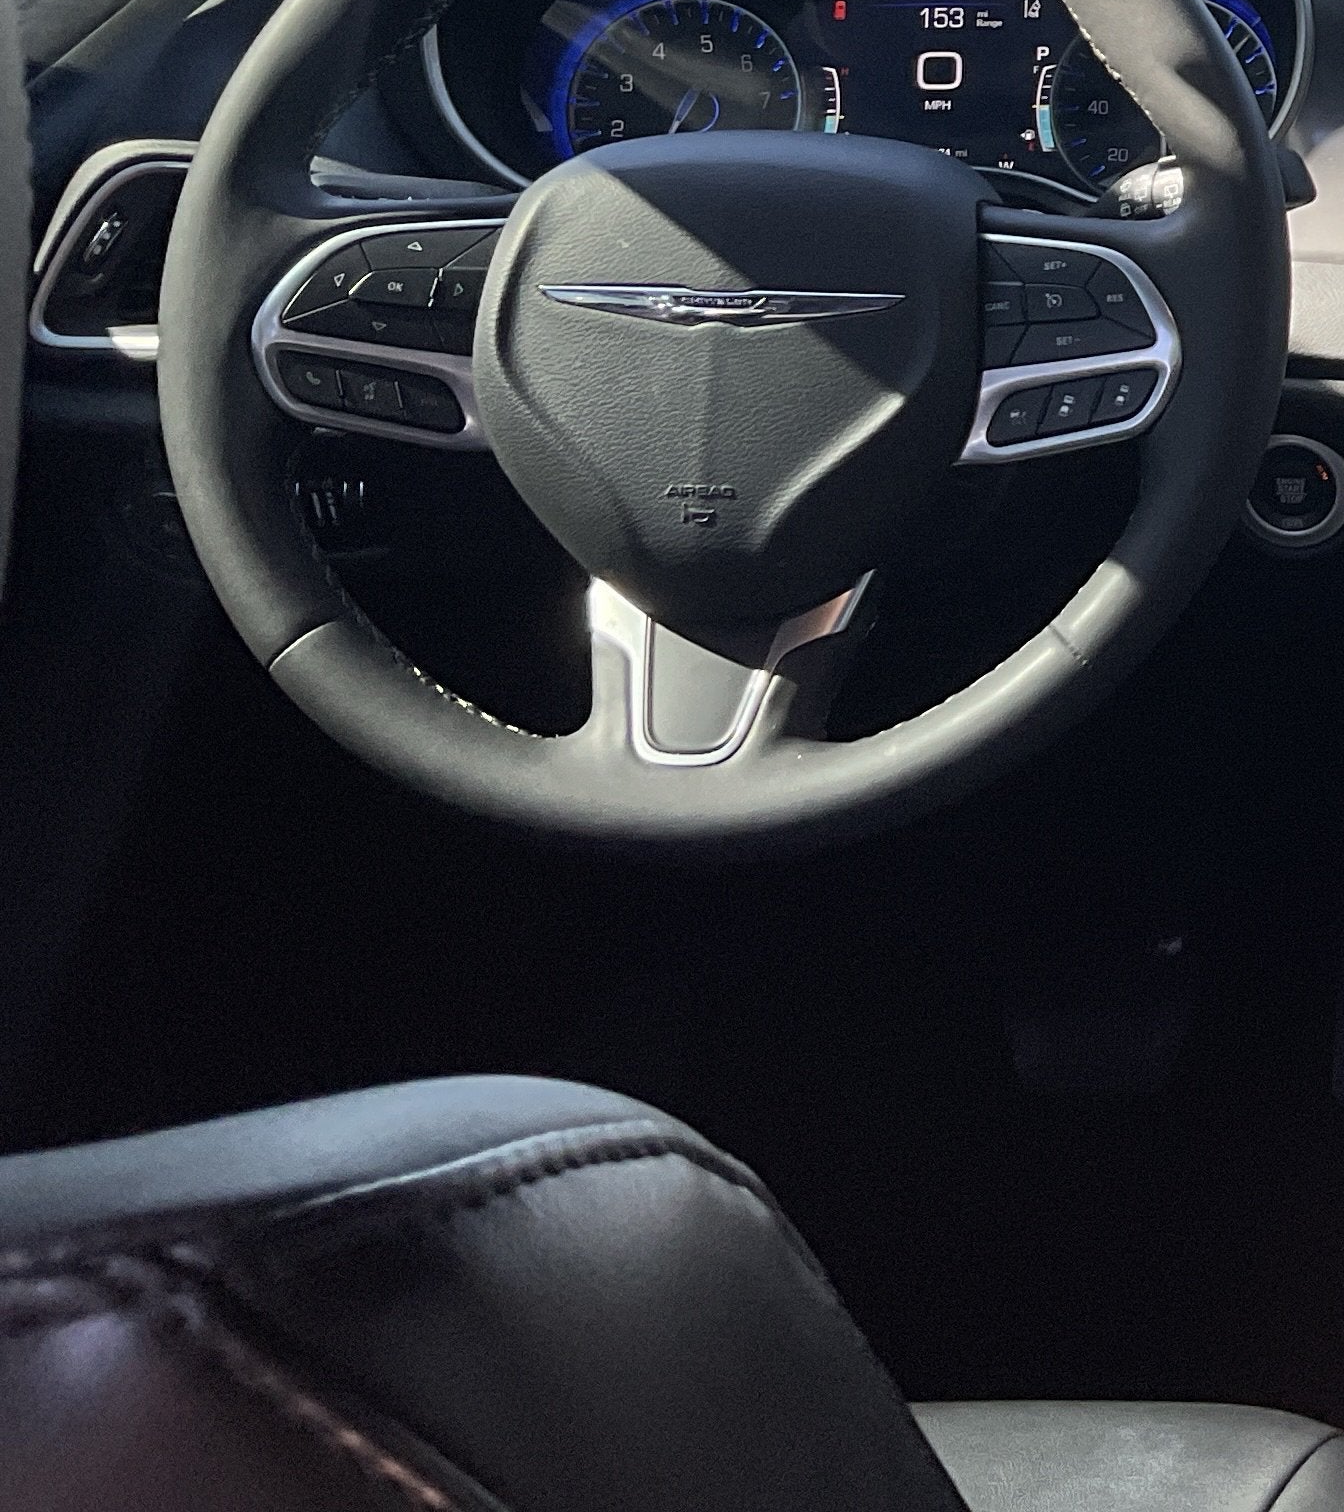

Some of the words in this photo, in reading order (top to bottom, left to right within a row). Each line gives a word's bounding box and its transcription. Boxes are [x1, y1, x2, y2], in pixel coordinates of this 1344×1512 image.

[920, 7, 965, 29] 153
[976, 10, 989, 18] mi
[976, 18, 1003, 28] Range
[652, 42, 666, 61] 4
[700, 34, 714, 54] 5
[1036, 46, 1050, 61] P
[740, 54, 753, 73] 6
[916, 51, 963, 91] 0
[619, 73, 634, 92] 3
[759, 91, 770, 109] 7
[924, 100, 951, 110] MPH
[1087, 99, 1109, 115] 40
[611, 120, 625, 138] 2
[1107, 147, 1129, 162] 20
[387, 281, 404, 292] OK
[1106, 293, 1124, 303] RES
